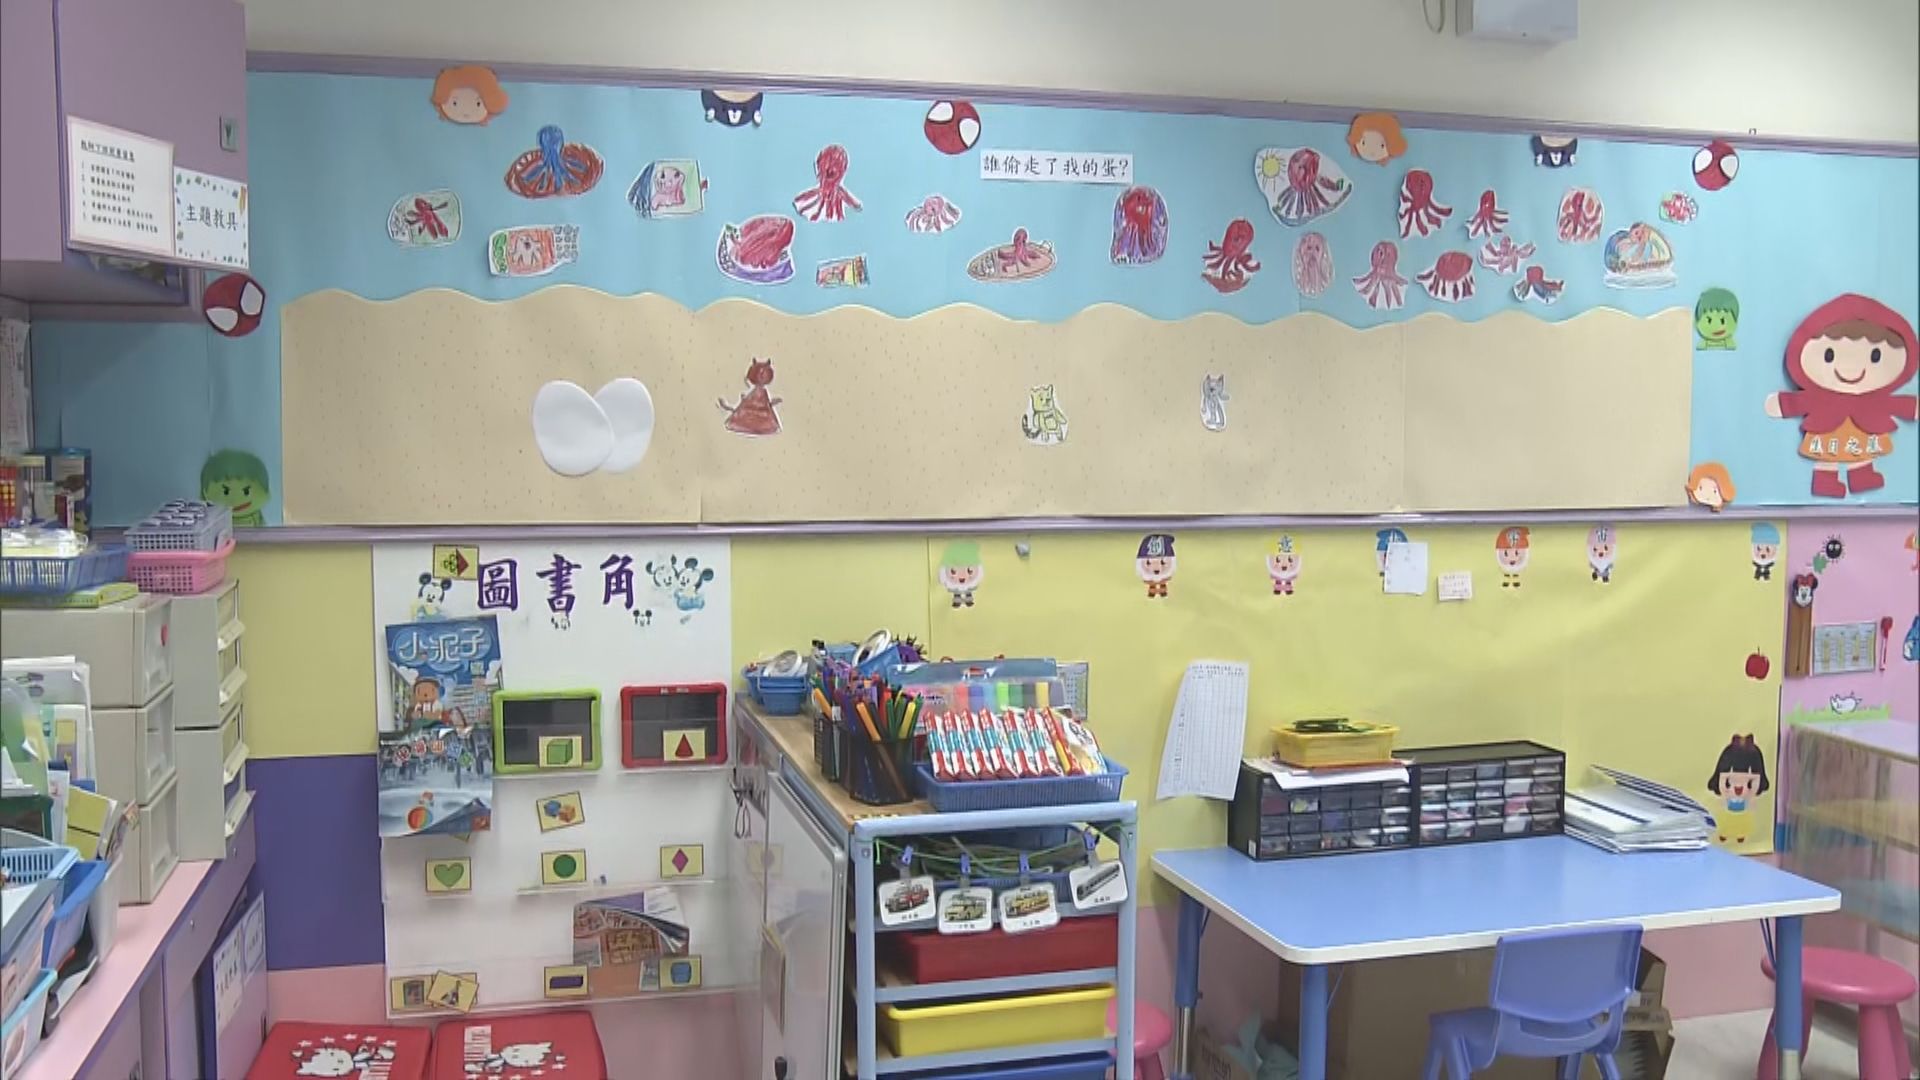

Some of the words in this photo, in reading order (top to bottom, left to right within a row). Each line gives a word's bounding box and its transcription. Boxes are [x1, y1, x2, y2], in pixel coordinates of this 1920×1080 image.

[983, 154, 1129, 177] 誰偷走了我的蛋?
[185, 203, 239, 231] 主題教具
[477, 554, 637, 615] 圖書角
